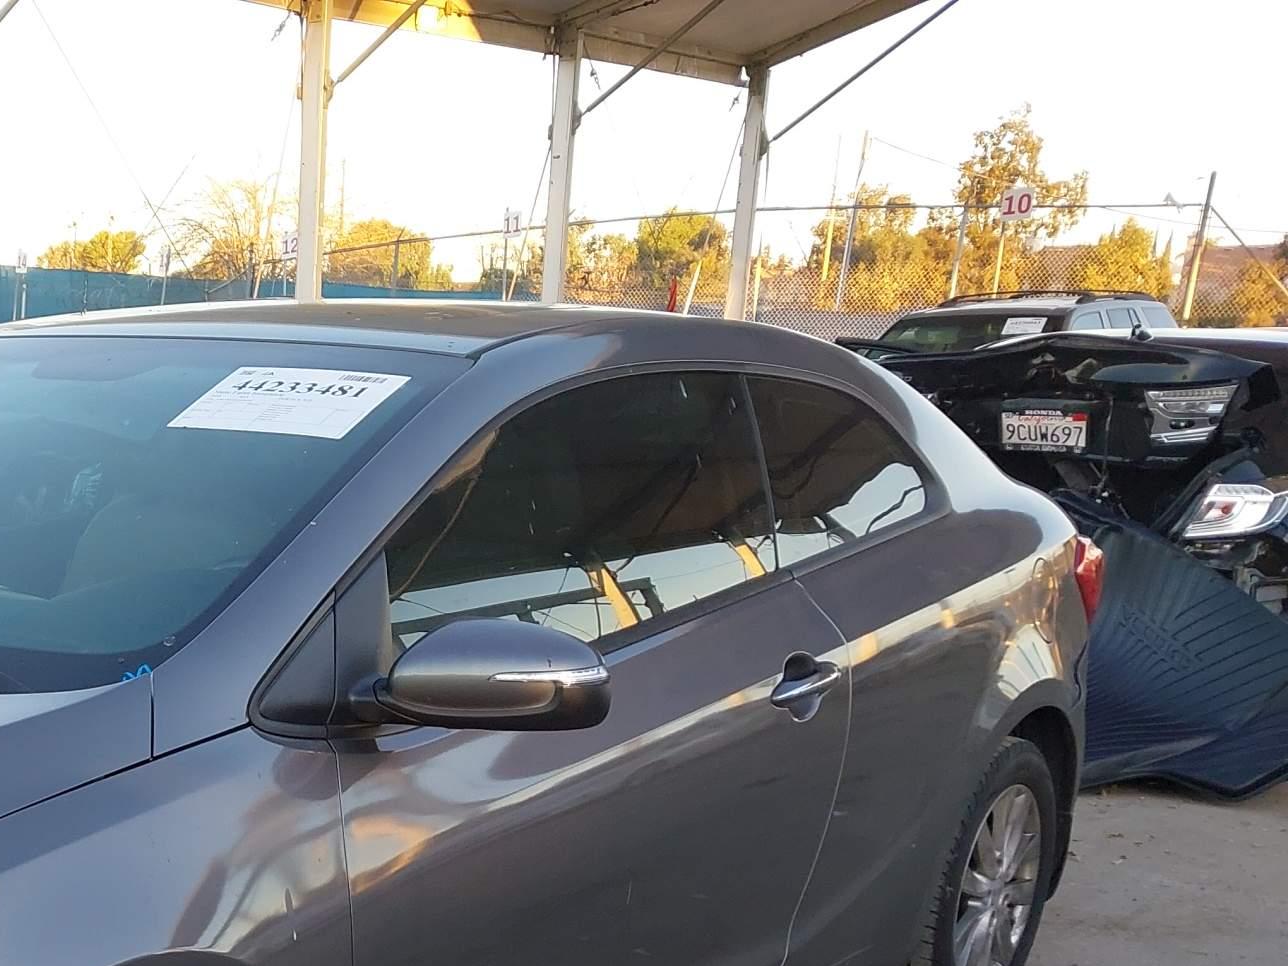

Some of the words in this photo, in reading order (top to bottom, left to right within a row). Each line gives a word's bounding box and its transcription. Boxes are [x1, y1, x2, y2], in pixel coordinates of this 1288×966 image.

[1002, 193, 1032, 216] 10
[503, 215, 521, 234] 11
[282, 237, 298, 255] 12
[231, 378, 369, 398] 44233481
[1005, 423, 1083, 447] 9CUW697
